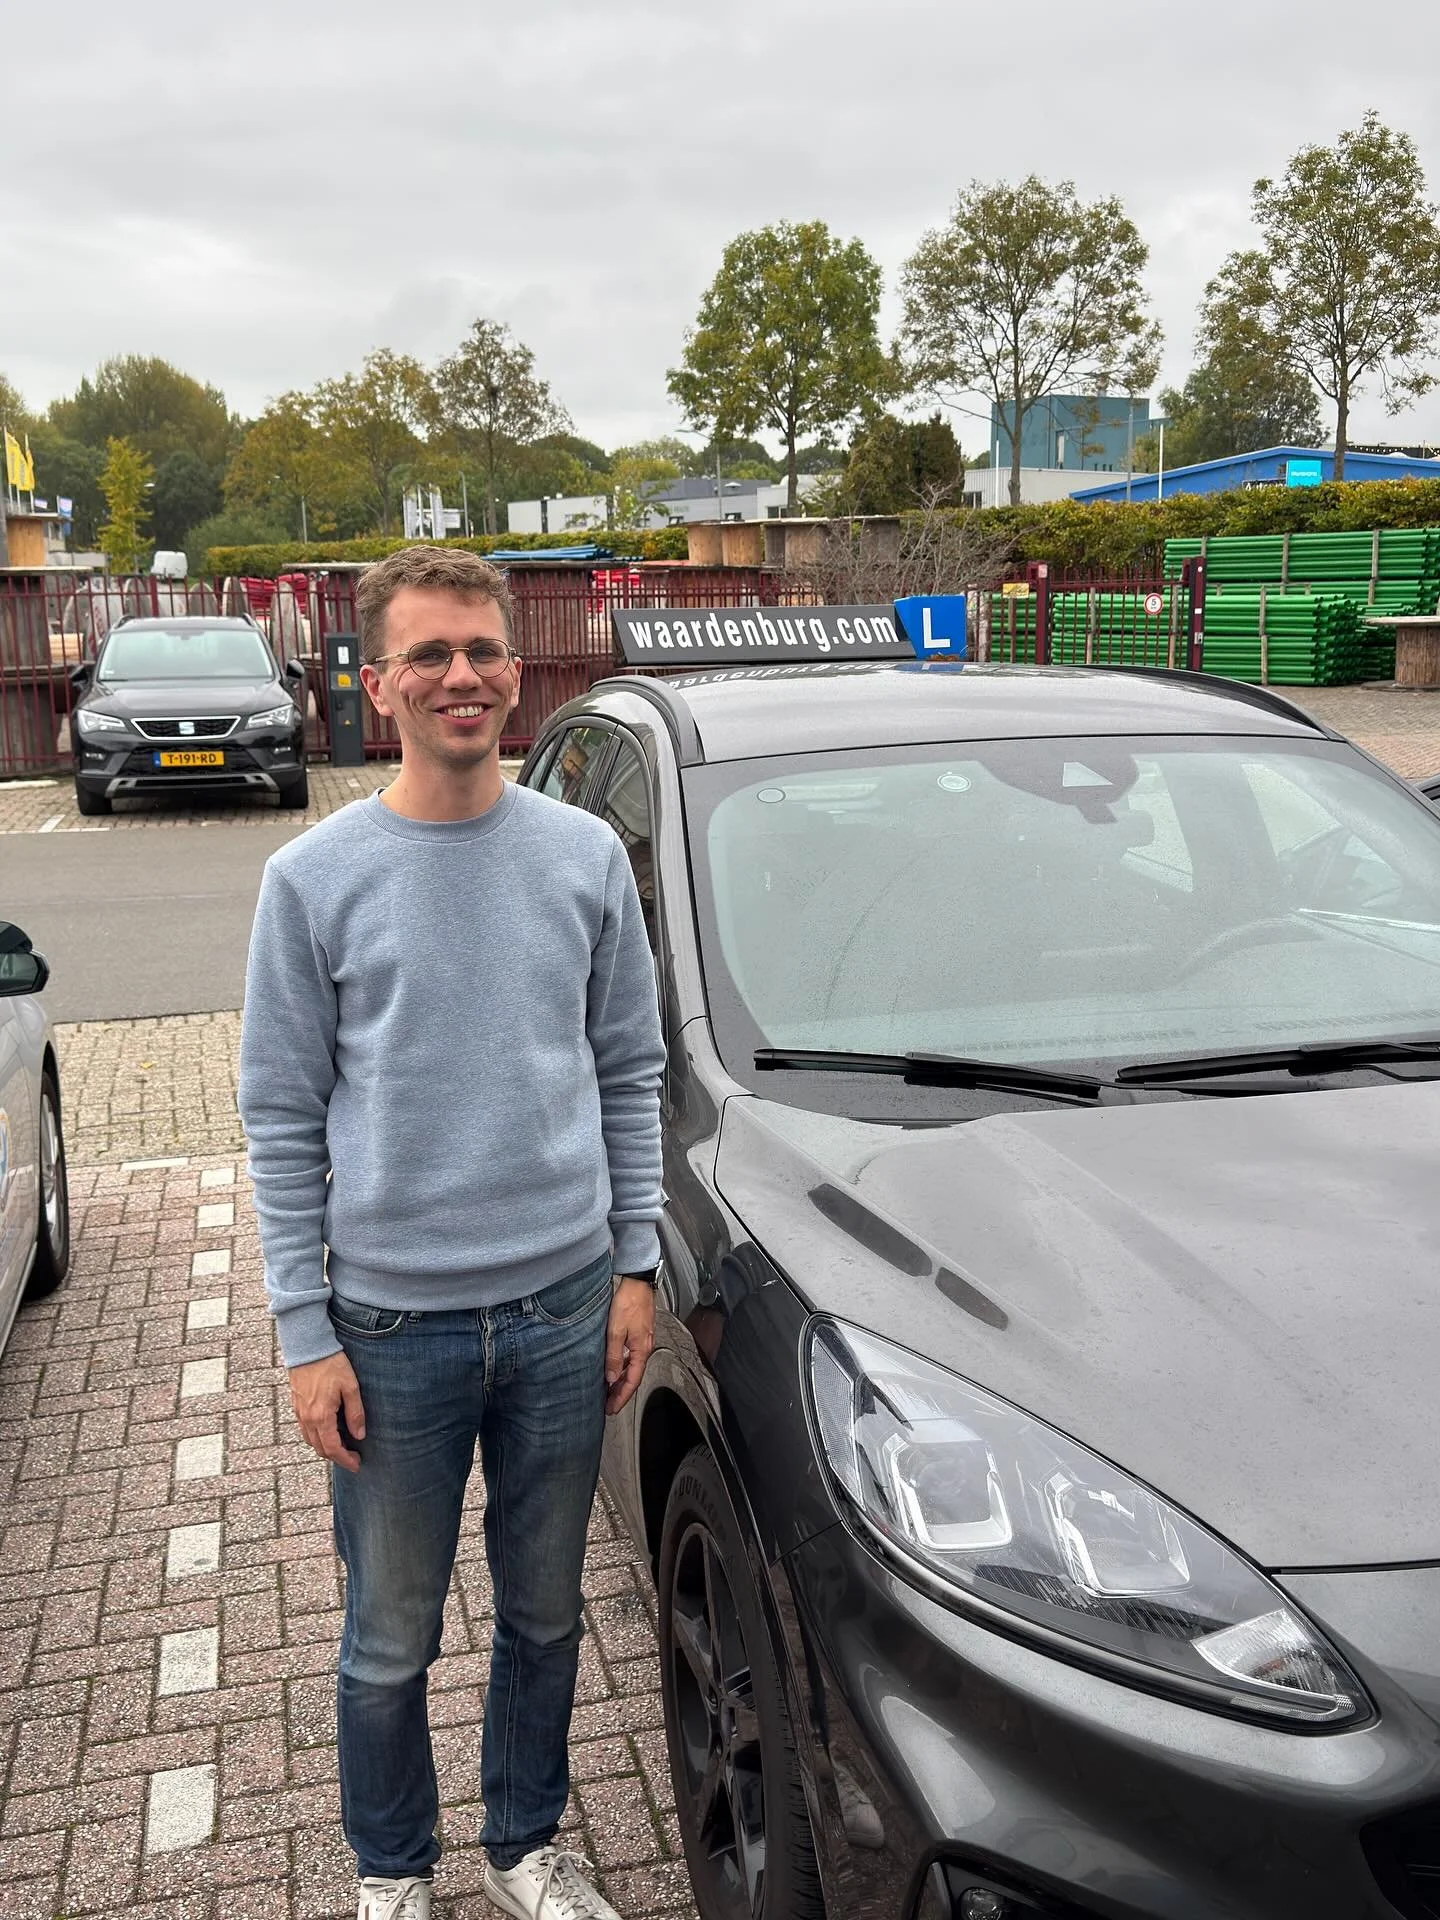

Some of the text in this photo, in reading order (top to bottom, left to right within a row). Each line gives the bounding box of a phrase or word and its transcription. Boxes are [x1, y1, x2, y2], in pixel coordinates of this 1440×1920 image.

[1151, 598, 1157, 606] 5
[628, 612, 900, 652] waardenburg.com
[922, 607, 951, 649] L
[167, 753, 217, 765] T-191-RD
